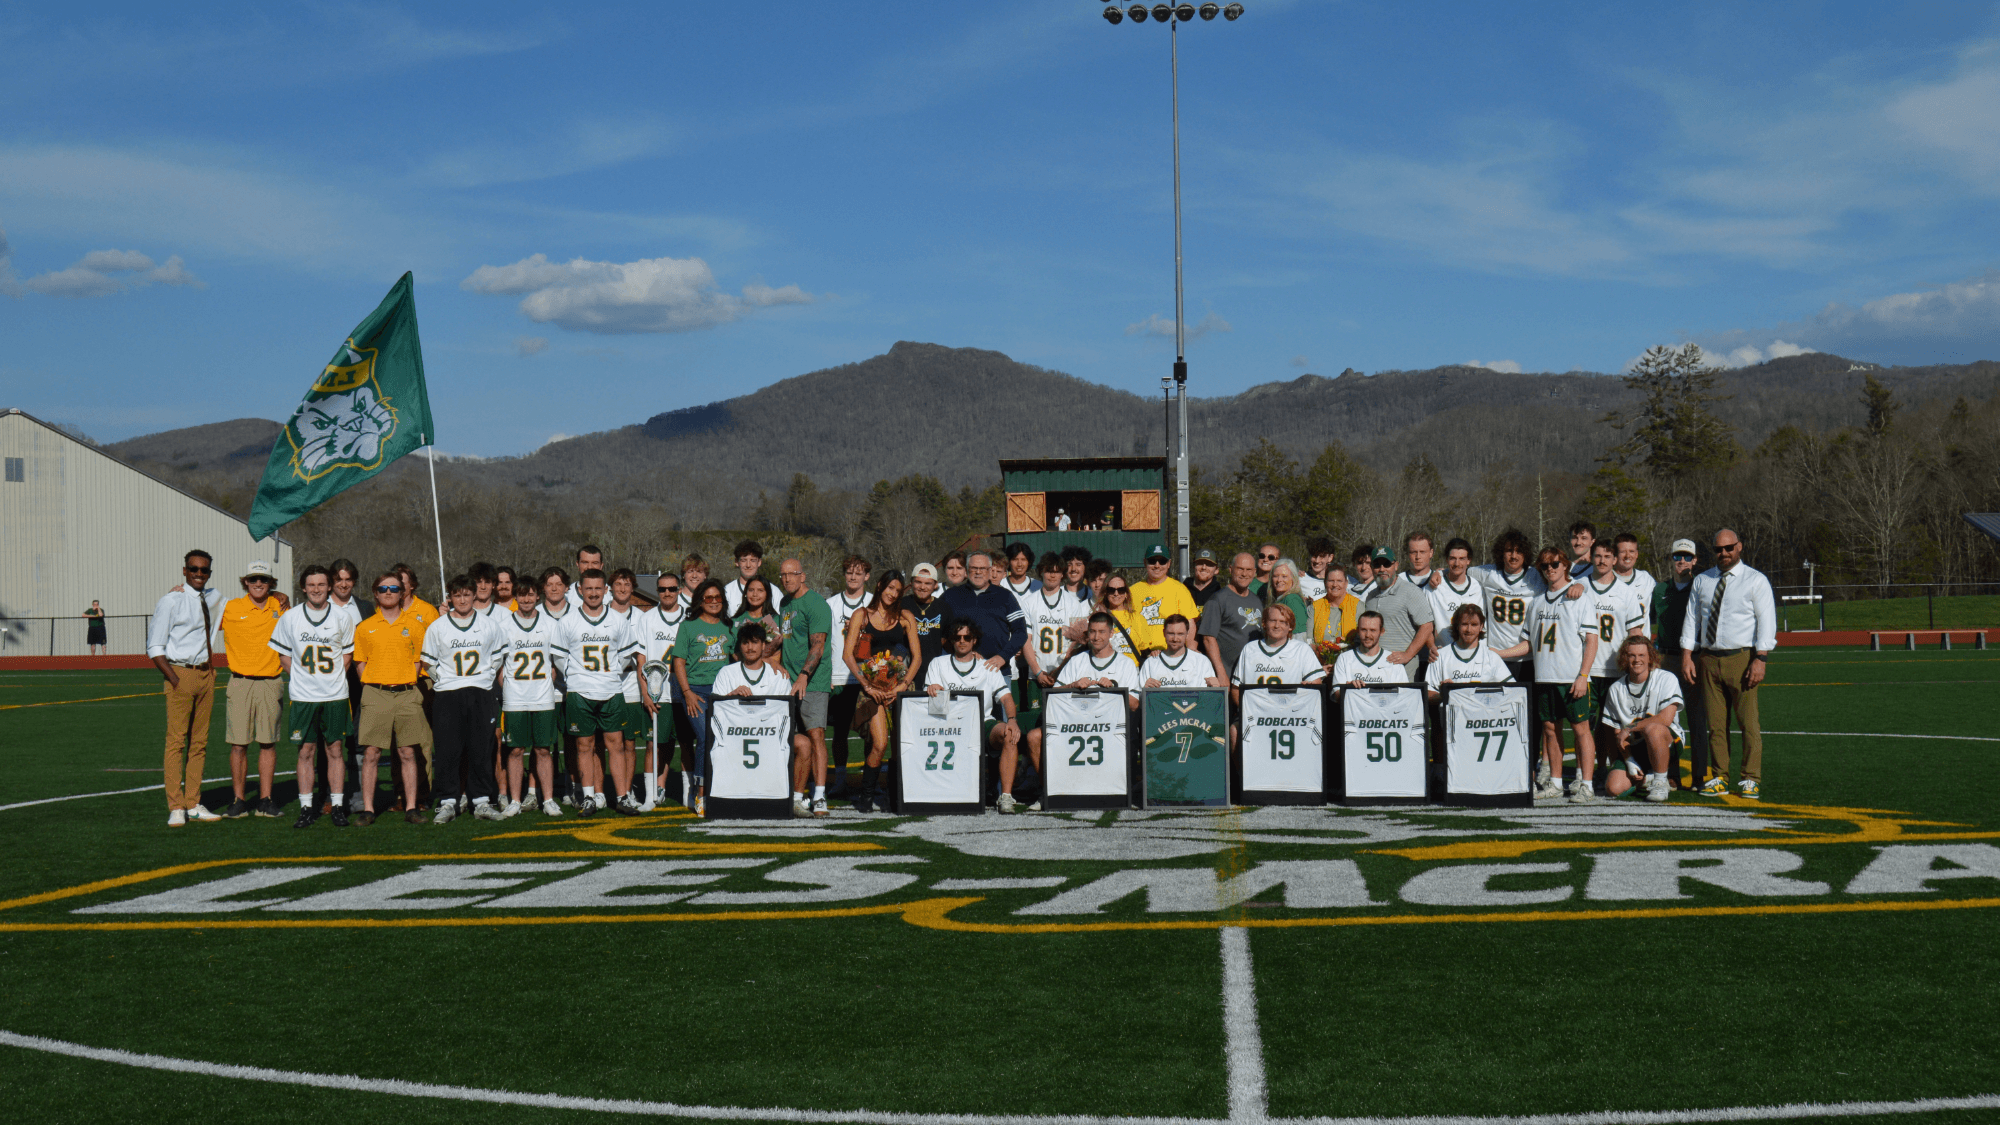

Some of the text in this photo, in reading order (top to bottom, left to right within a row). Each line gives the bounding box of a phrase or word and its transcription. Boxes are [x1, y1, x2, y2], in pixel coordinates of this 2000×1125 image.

[1492, 595, 1526, 626] 88
[299, 631, 331, 643] Bobcats
[580, 632, 611, 642] Bobcats
[1537, 623, 1557, 653] 14
[1596, 613, 1615, 642] 8
[450, 638, 482, 649] Bobcats
[514, 639, 544, 650] Bobcats
[1039, 626, 1063, 654] 61
[301, 644, 335, 674] 45
[453, 649, 481, 677] 12
[513, 650, 547, 680] 22
[582, 645, 611, 673] 51
[1254, 663, 1286, 673] Bobcats
[1160, 676, 1188, 687] Bobcats
[1354, 672, 1384, 683] Bobcats
[1452, 669, 1481, 680] Bobcats
[727, 726, 777, 736] BOBCATS
[919, 727, 962, 736] LEES-McRAE
[1060, 722, 1111, 734] BOBCATS
[1157, 718, 1212, 735] LEES MCRAE
[1257, 717, 1308, 727] BOBCATS
[1358, 719, 1409, 729] BOBCATS
[1465, 717, 1516, 729] BOBCATS
[742, 739, 760, 769] 5
[925, 740, 956, 771] 22
[1068, 735, 1104, 766] 23
[1175, 732, 1193, 763] 7
[1269, 729, 1296, 760] 19
[1366, 731, 1402, 763] 50
[1473, 730, 1509, 762] 77
